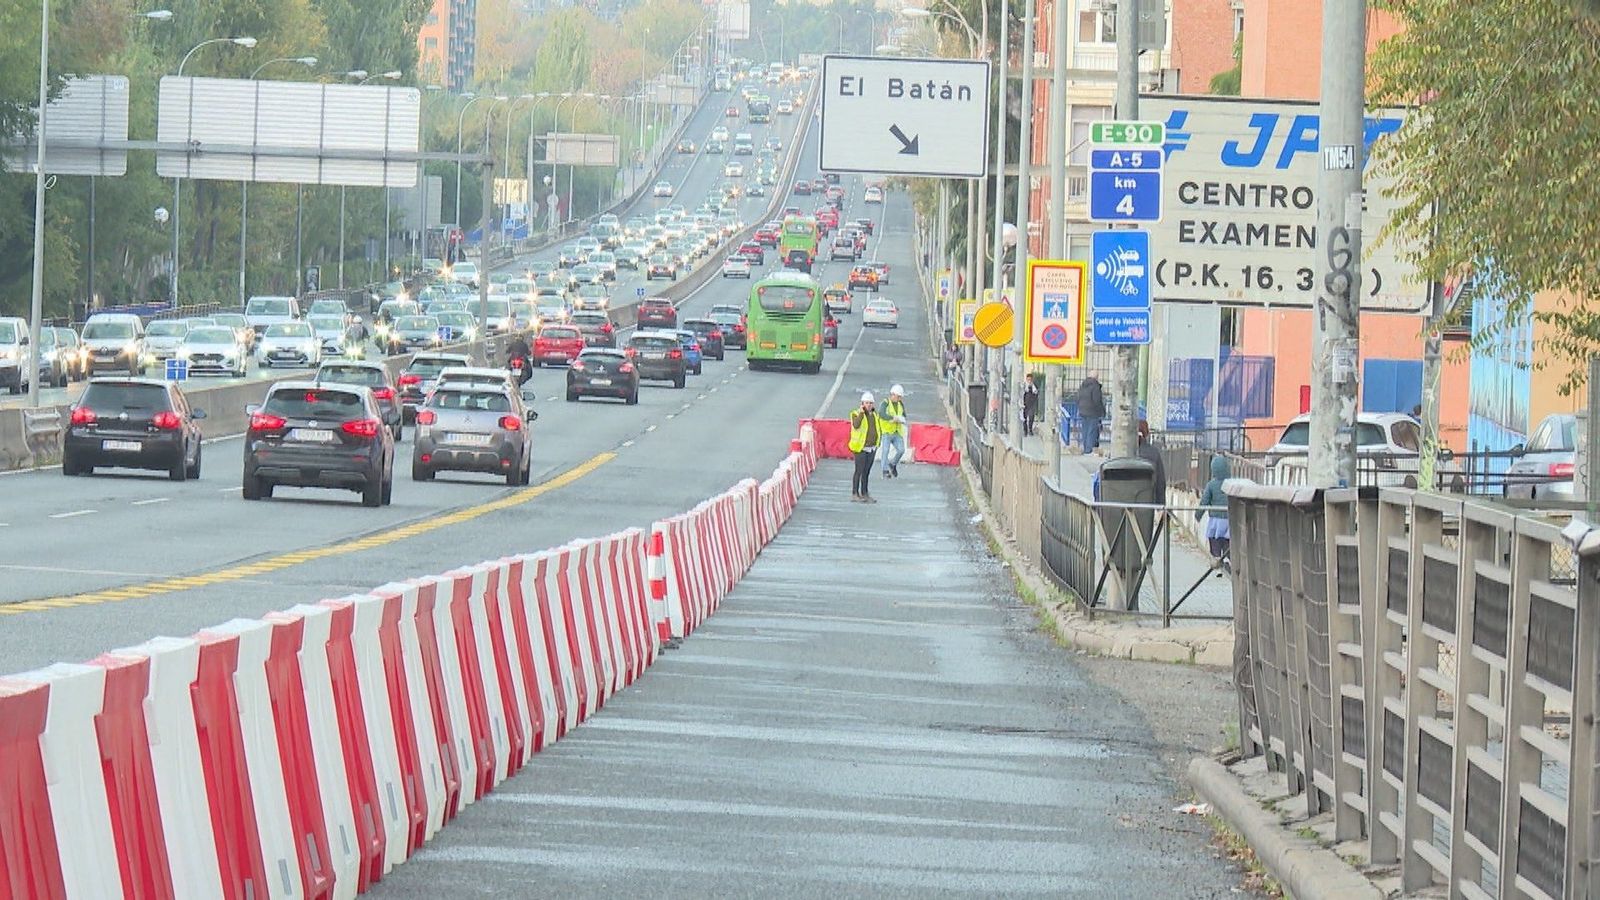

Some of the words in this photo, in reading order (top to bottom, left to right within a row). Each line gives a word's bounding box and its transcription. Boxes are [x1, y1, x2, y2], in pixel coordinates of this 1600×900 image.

[839, 76, 864, 97] El
[888, 78, 972, 101] Batán
[1100, 123, 1154, 143] E-90
[1109, 151, 1143, 168] A-5
[1324, 145, 1355, 171] TM54
[1114, 176, 1137, 189] km
[1115, 194, 1136, 216] 4
[1178, 180, 1314, 210] CENTRO
[1095, 317, 1114, 326] Control
[1122, 317, 1147, 326] Velocidad
